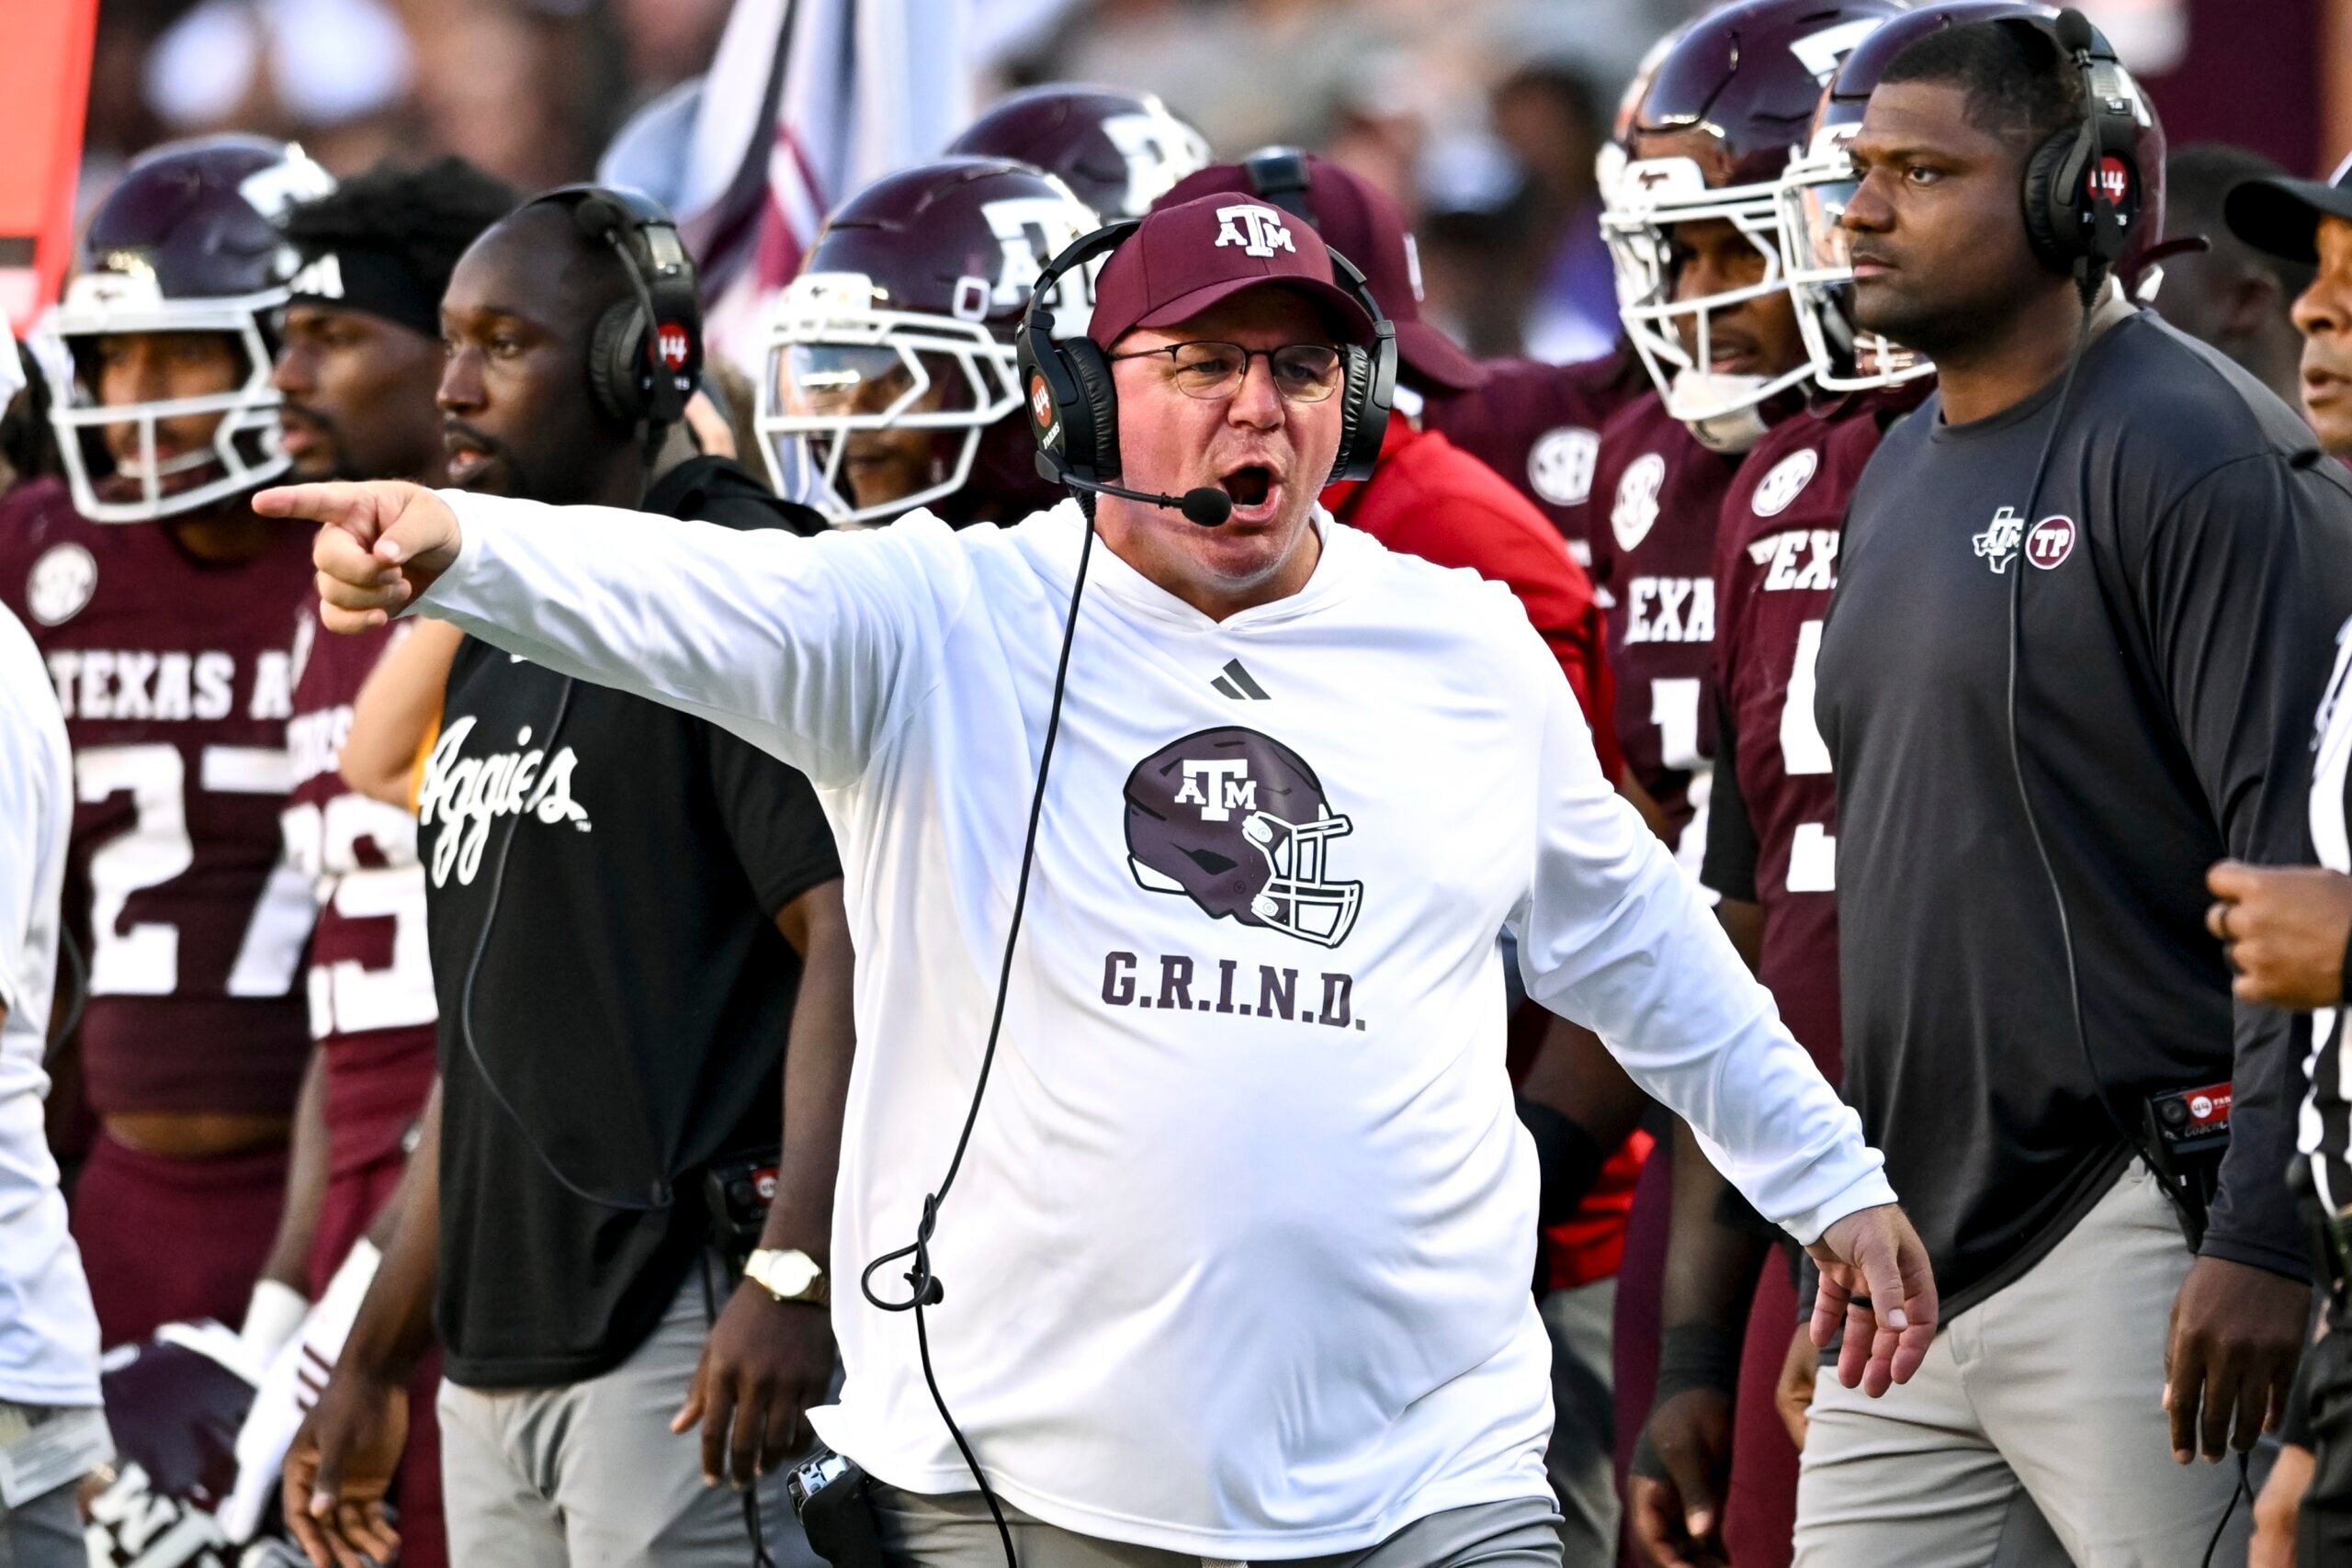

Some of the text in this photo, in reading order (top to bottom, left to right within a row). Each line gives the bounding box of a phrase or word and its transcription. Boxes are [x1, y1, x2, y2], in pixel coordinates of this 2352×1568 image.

[1032, 385, 1050, 417] 44
[1042, 421, 1060, 450] FARMS
[2035, 528, 2071, 558] TP
[48, 650, 235, 720] TEXAS
[75, 744, 317, 997] 27
[1101, 951, 1367, 1032] G.R.I.N.D.
